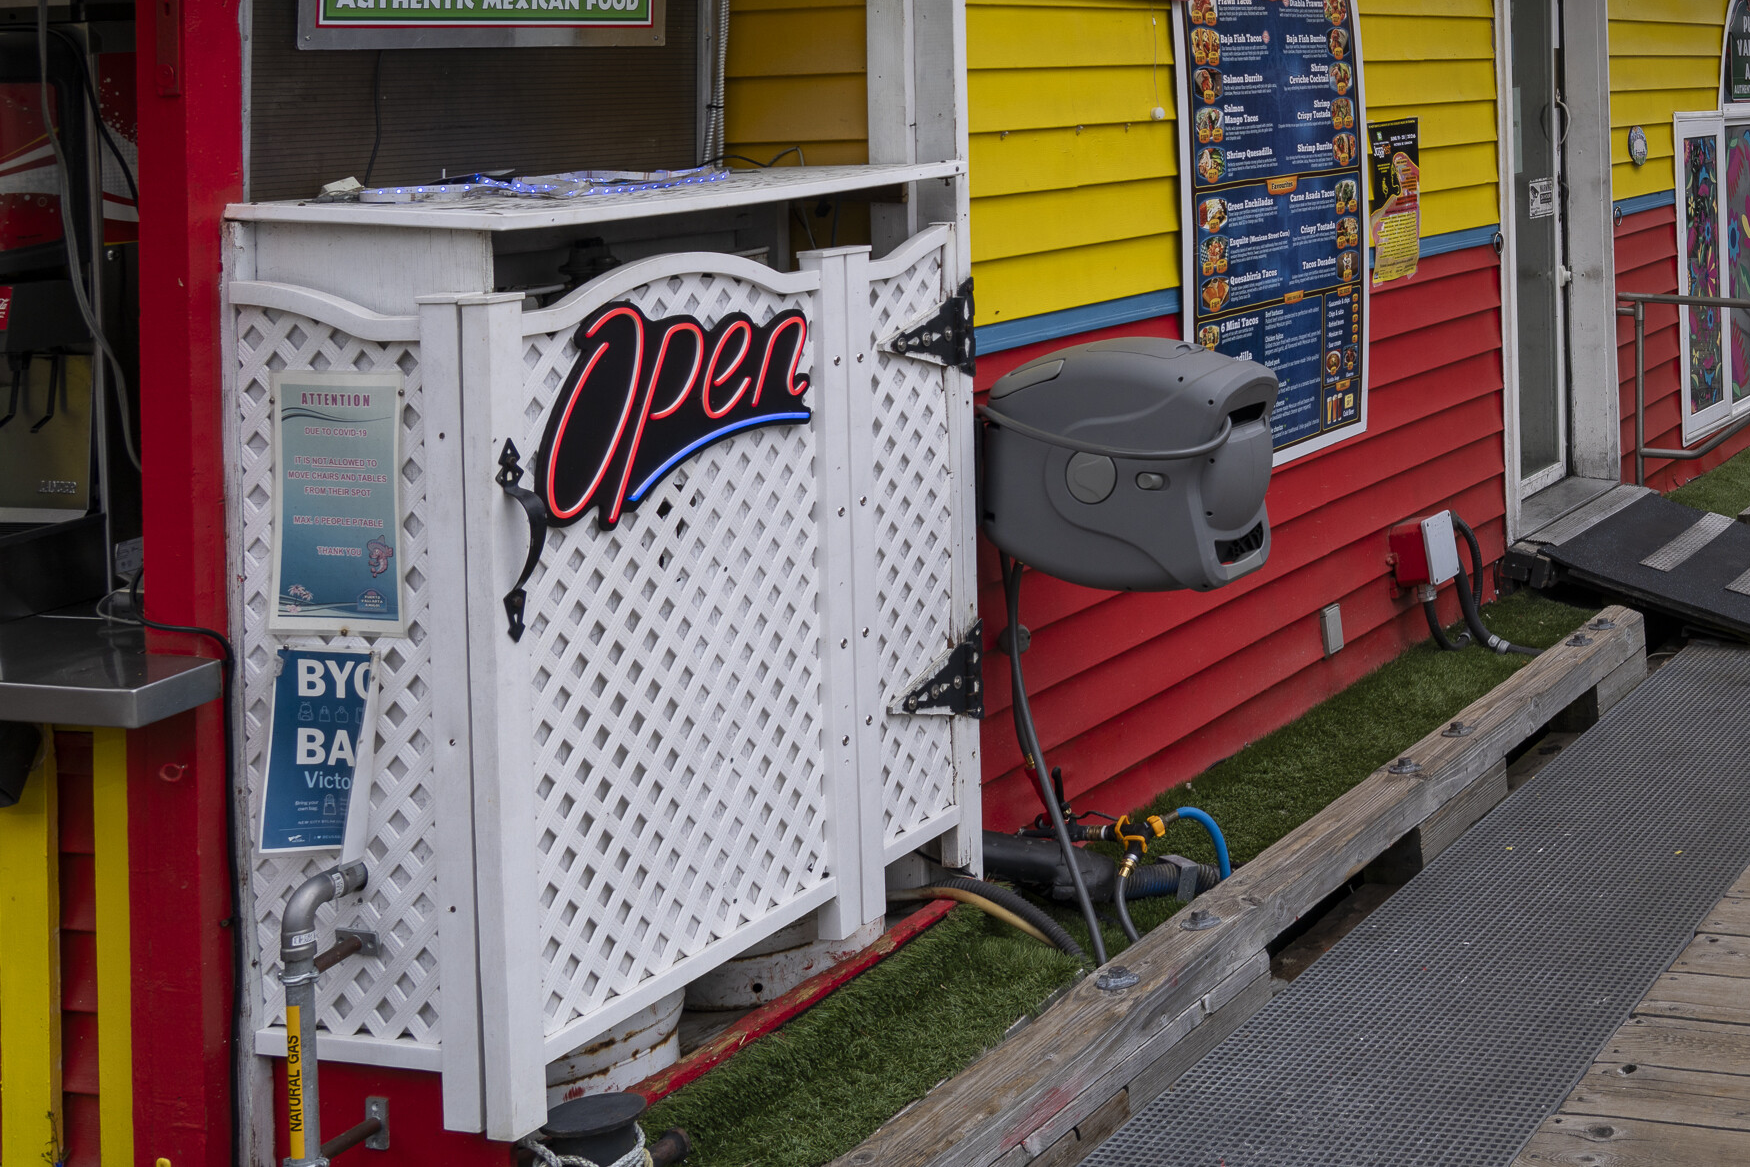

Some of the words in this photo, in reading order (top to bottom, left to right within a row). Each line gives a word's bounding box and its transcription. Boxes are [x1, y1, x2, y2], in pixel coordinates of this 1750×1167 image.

[1305, 0, 1323, 7] Prawns
[1220, 34, 1233, 45] Baja
[1233, 34, 1246, 43] Fish
[1247, 34, 1262, 43] Tacos
[1286, 34, 1298, 44] Baja
[1298, 34, 1309, 43] Fish
[1310, 34, 1327, 43] Burrito
[1311, 63, 1329, 73] Shrimp
[1223, 74, 1244, 84] Salmon
[1244, 73, 1263, 83] Burrito
[1309, 74, 1330, 83] Cocktail
[1224, 103, 1244, 113] Salmon
[1313, 99, 1331, 109] Shrimp
[1224, 115, 1243, 125] Mango
[1243, 114, 1259, 123] Tacos
[1297, 111, 1312, 121] Crispy
[1312, 109, 1331, 119] Tostada
[1297, 143, 1316, 153] Shrimp
[1316, 141, 1333, 151] Burrito
[1226, 150, 1246, 160] Shrimp
[1246, 146, 1273, 157] Quesadilla
[1271, 181, 1293, 190] Favourites
[1290, 193, 1305, 203] Carne
[1305, 191, 1320, 200] Asada
[1320, 189, 1335, 198] Tacos
[1227, 202, 1244, 212] Green
[1244, 196, 1274, 209] Enchiladas
[1301, 225, 1317, 235] Crispy
[1317, 221, 1336, 231] Tostada
[1229, 236, 1249, 248] Esquite
[1302, 260, 1317, 270] Tacos
[1317, 256, 1337, 267] Dorados
[1261, 268, 1278, 279] Tacos
[1220, 323, 1226, 332] 6
[1226, 319, 1241, 331] Mini
[1241, 316, 1259, 327] Tacos
[301, 392, 371, 407] ATTENTION
[546, 306, 808, 524] Open
[304, 427, 320, 436] DUE
[321, 428, 332, 436] TO
[333, 428, 368, 437] COVID-19
[294, 456, 303, 465] IT
[303, 457, 311, 465] IS
[312, 457, 327, 466] NOT
[328, 458, 366, 467] ALLOWED
[366, 459, 378, 468] TO
[288, 471, 310, 480] MOVE
[311, 472, 340, 481] CHAIRS
[340, 473, 357, 482] AND
[357, 474, 388, 483] TABLES
[304, 486, 327, 495] FROM
[327, 487, 350, 496] THEIR
[350, 488, 372, 497] SPOT
[293, 515, 313, 525] MAX.
[314, 516, 320, 524] 6
[320, 517, 351, 526] PEOPLE
[316, 546, 345, 556] THANK
[345, 548, 362, 557] YOU
[287, 1034, 300, 1065] GAS
[288, 1068, 303, 1133] NATURAL
